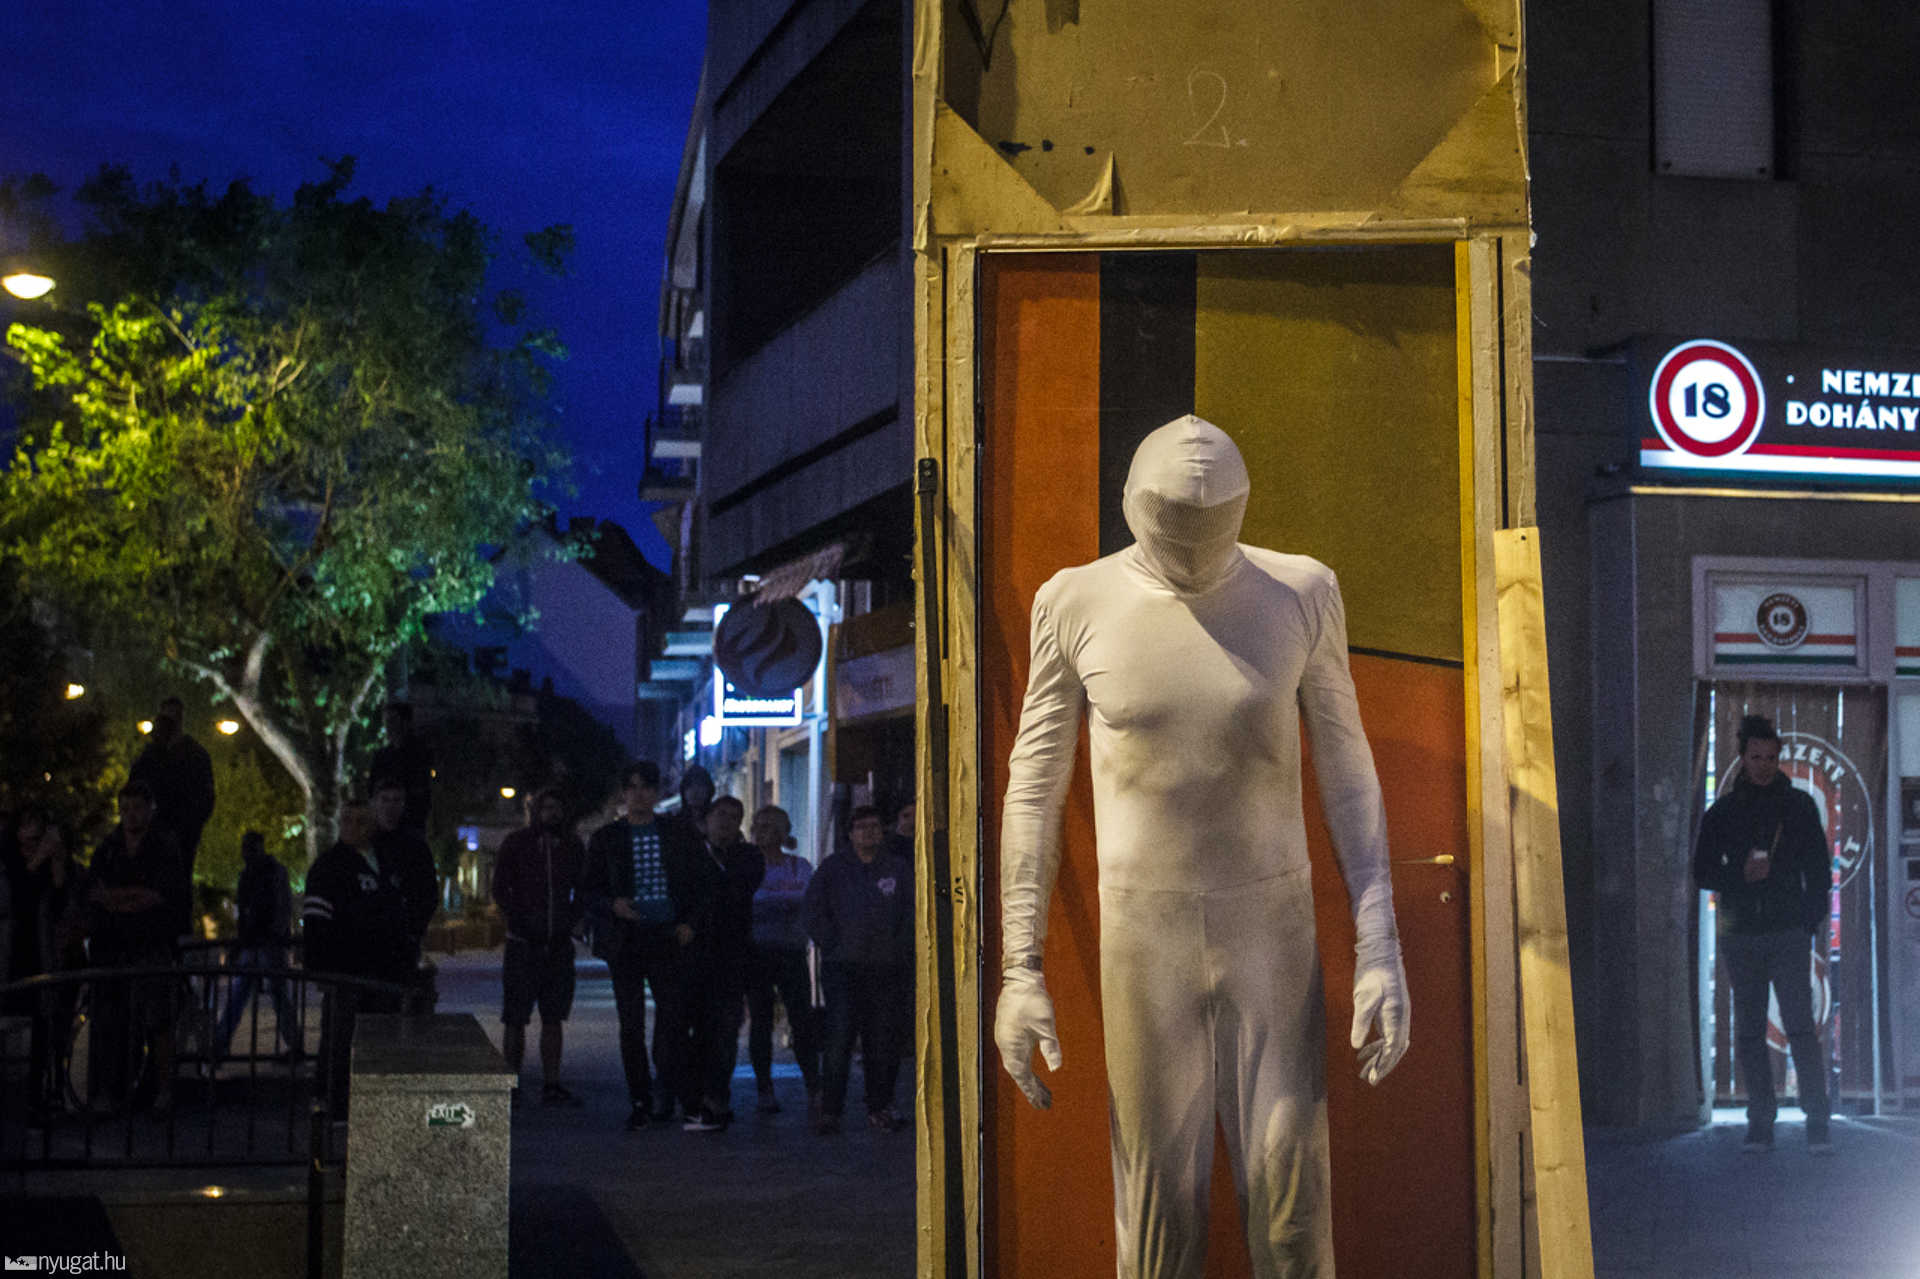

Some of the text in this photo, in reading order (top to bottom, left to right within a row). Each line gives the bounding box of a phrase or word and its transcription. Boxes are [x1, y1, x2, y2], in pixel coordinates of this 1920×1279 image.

[1684, 382, 1731, 419] 18
[1785, 399, 1920, 432] DOHÁNY
[1773, 612, 1791, 627] 18
